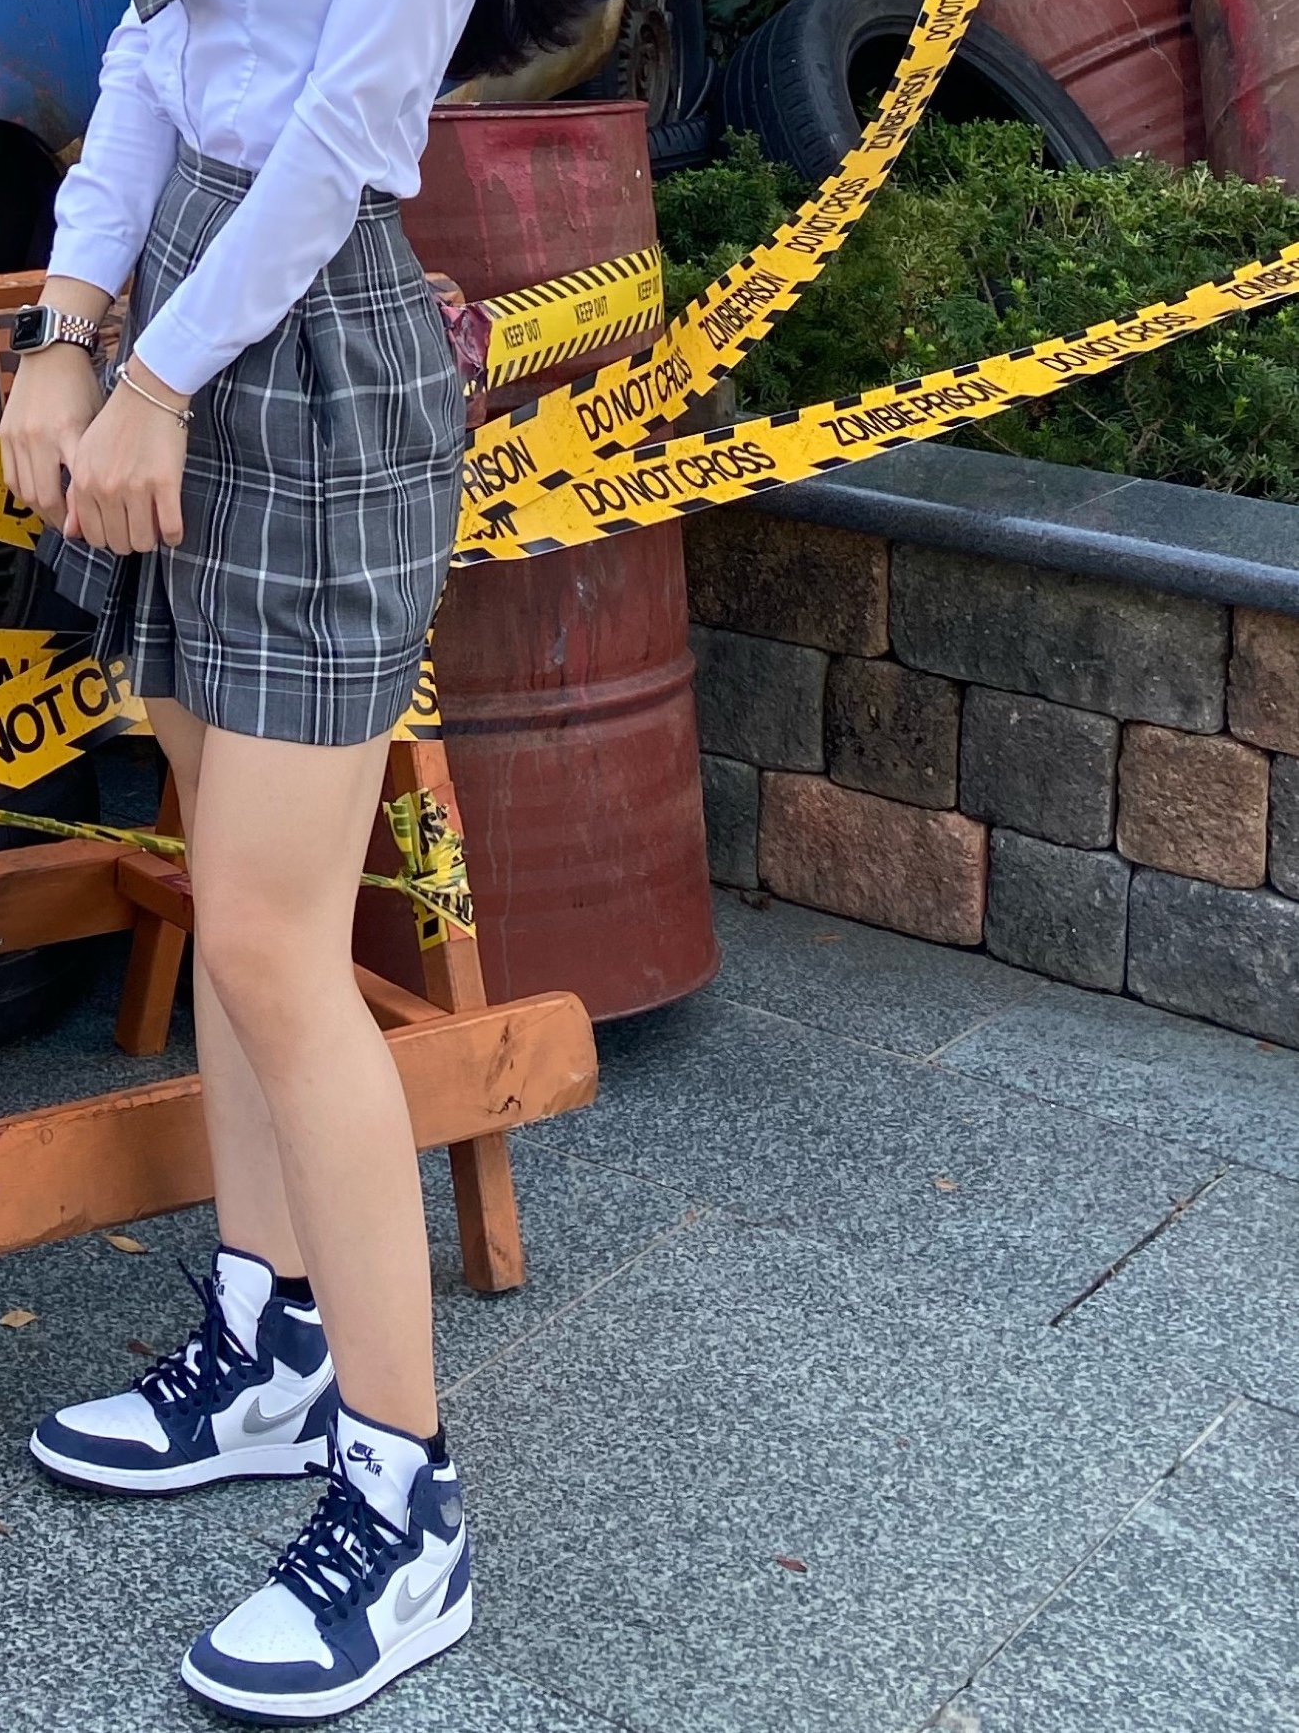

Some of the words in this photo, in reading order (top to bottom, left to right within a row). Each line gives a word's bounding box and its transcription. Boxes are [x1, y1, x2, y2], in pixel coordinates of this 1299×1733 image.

[925, 23, 955, 41] DO
[819, 177, 870, 214] CROSS
[785, 235, 823, 254] DO
[799, 214, 843, 238] NOT
[502, 324, 524, 350] KEEP
[524, 318, 542, 344] OUT
[573, 299, 594, 326] KEEP
[594, 295, 609, 319] OUT
[698, 296, 754, 352] ZOMBIE
[737, 268, 790, 316] PRISON
[571, 477, 627, 517] DO
[614, 464, 685, 506] NOT
[676, 441, 777, 489] CROSS
[819, 400, 929, 447] ZOMBIE
[915, 378, 1009, 424] PRISON
[1036, 352, 1088, 373] DO
[1068, 335, 1130, 360] NOT
[1114, 312, 1197, 343] CROSS
[576, 394, 614, 442] DO
[609, 371, 654, 426] NOT
